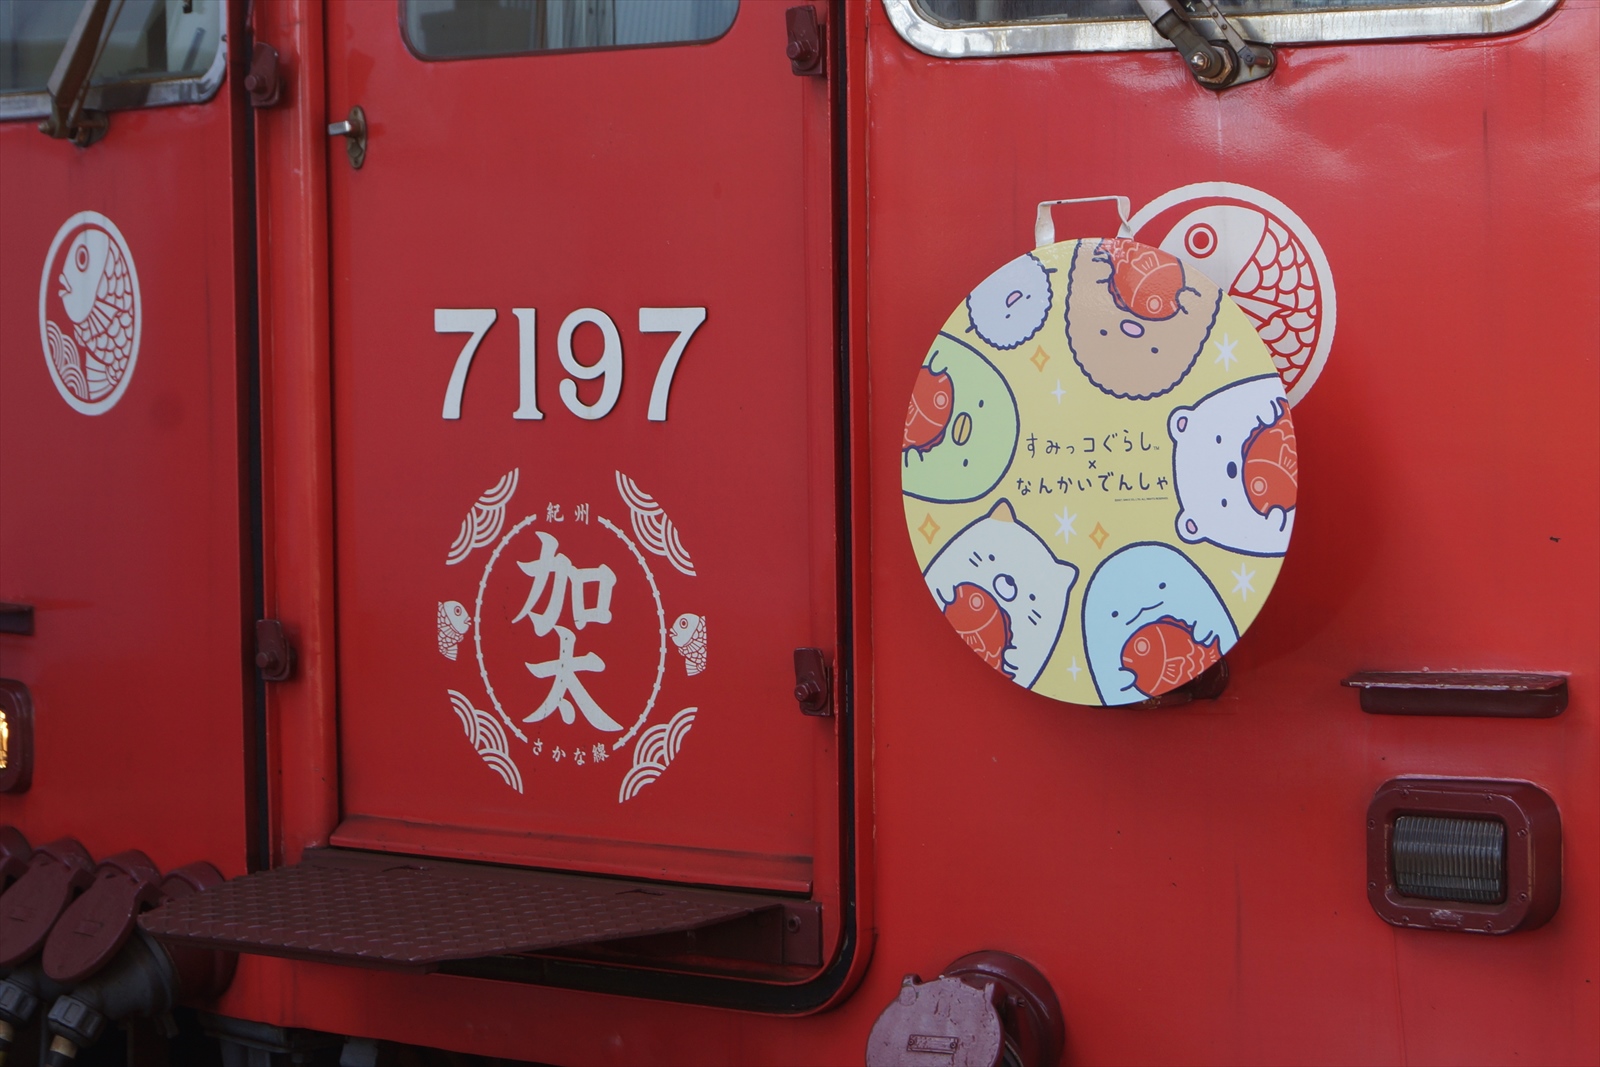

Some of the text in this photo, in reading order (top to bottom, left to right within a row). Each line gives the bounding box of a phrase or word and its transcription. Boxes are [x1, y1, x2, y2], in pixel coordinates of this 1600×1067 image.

[434, 307, 707, 421] 7197
[1016, 471, 1168, 496] なんかいでんしゃ
[546, 501, 590, 525] 紀州
[511, 531, 624, 732] 加太
[532, 738, 610, 765] さかな線
